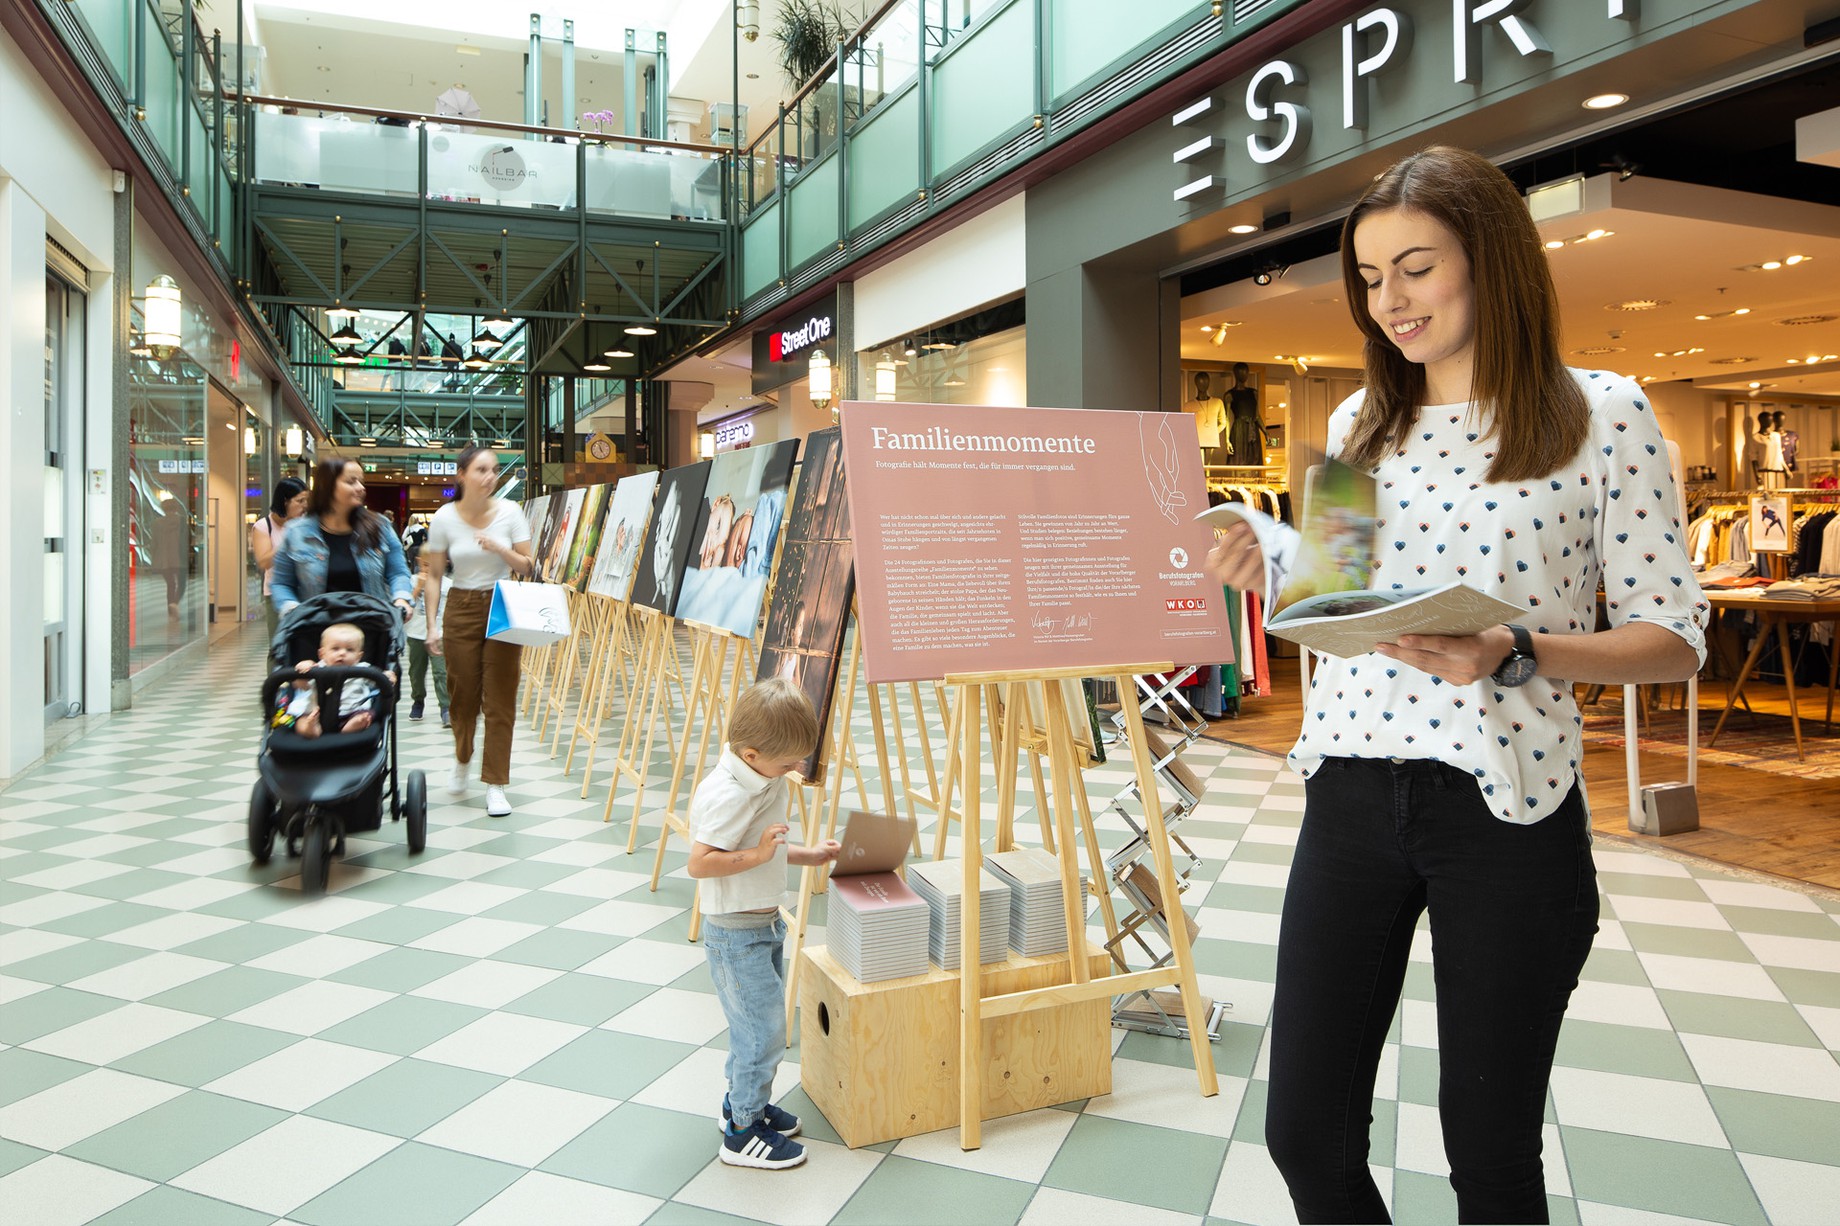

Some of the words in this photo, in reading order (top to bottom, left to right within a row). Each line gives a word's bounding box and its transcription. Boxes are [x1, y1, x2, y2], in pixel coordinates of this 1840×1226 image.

[468, 165, 538, 178] NAILBAR
[781, 322, 809, 355] Street
[808, 316, 831, 343] One
[871, 426, 1096, 454] Familienmomente
[876, 460, 912, 470] Fotografie
[913, 461, 927, 469] hält
[928, 461, 962, 469] Momente
[963, 462, 978, 471] fest,
[979, 462, 990, 470] die
[991, 462, 1001, 470] für
[1002, 462, 1024, 470] immer
[1025, 464, 1059, 472] vergangen
[1060, 463, 1076, 471] sind.
